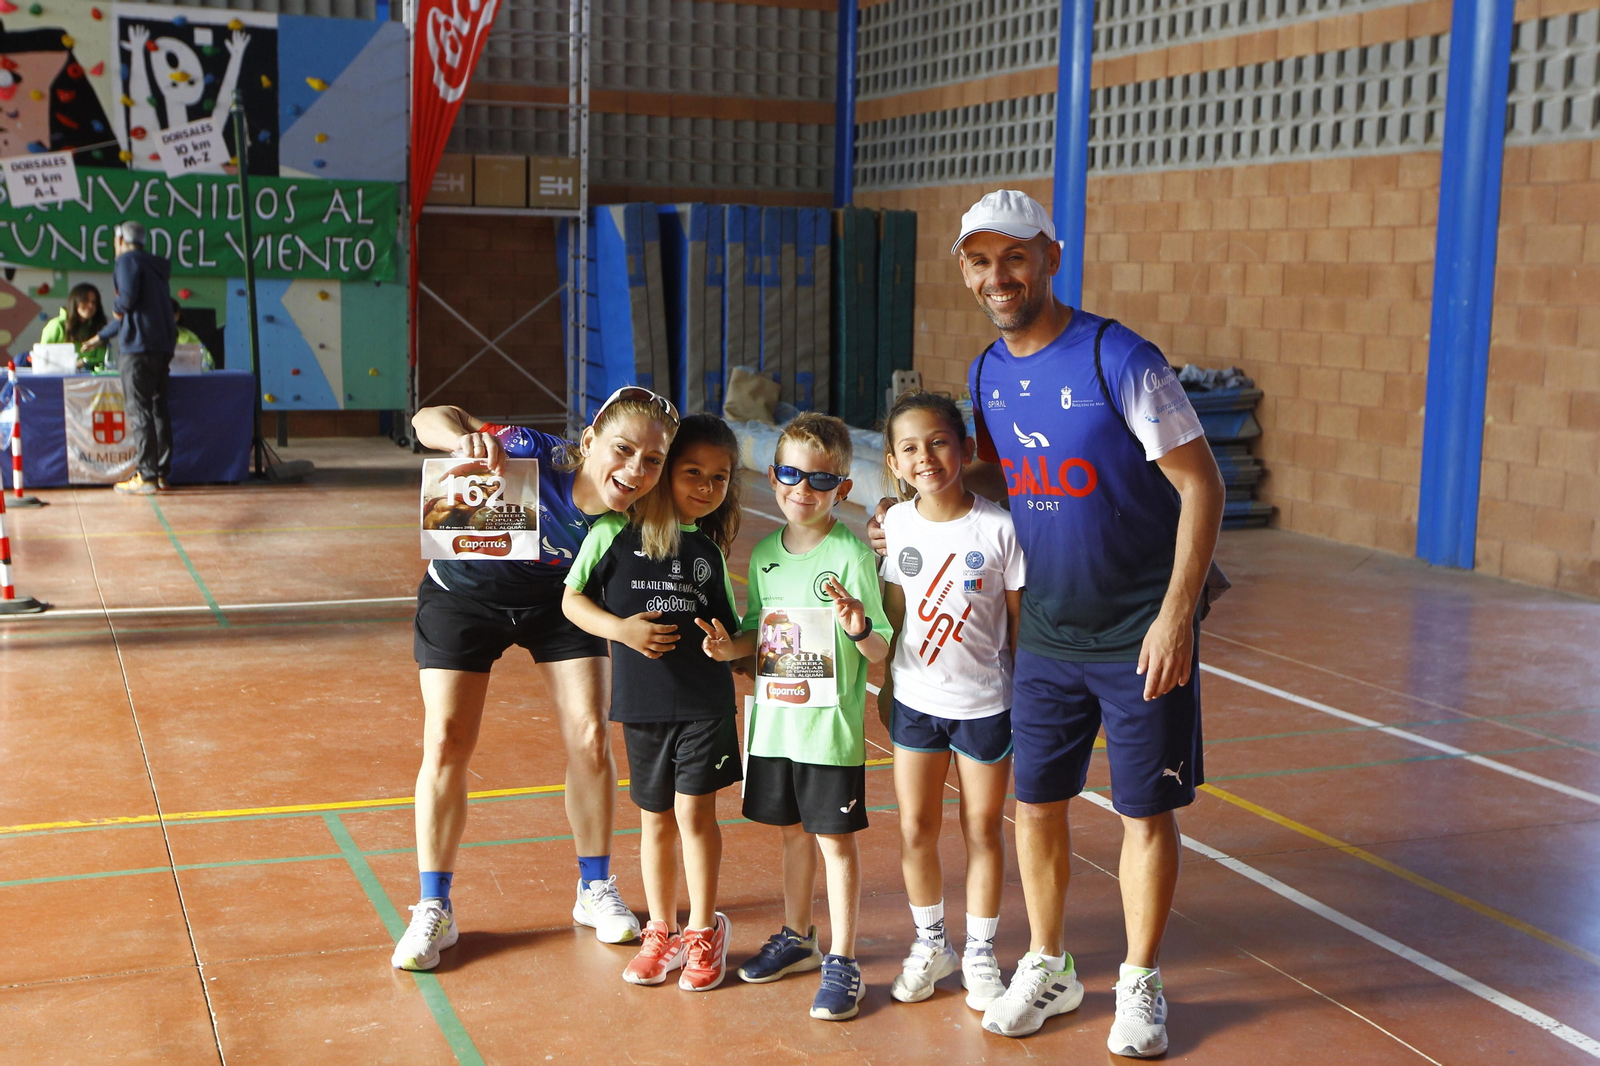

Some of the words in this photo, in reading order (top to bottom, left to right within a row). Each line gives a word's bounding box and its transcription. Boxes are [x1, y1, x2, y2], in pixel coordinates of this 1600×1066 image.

[161, 122, 213, 145] DORSALES
[174, 144, 188, 156] 10
[191, 140, 211, 151] km
[11, 156, 67, 172] DORSALES
[183, 151, 210, 168] M-Z
[23, 174, 37, 185] 10
[42, 172, 62, 183] km
[34, 185, 57, 197] A-L
[322, 188, 374, 224] AL
[0, 211, 111, 264] ÚNE
[150, 228, 217, 268] DEL
[224, 231, 375, 272] VIENTO
[1000, 455, 1098, 497] GALO
[440, 474, 507, 507] 162
[485, 505, 526, 513] XIII
[630, 580, 646, 589] CLUB
[762, 623, 800, 654] 841
[785, 653, 823, 661] XIII
